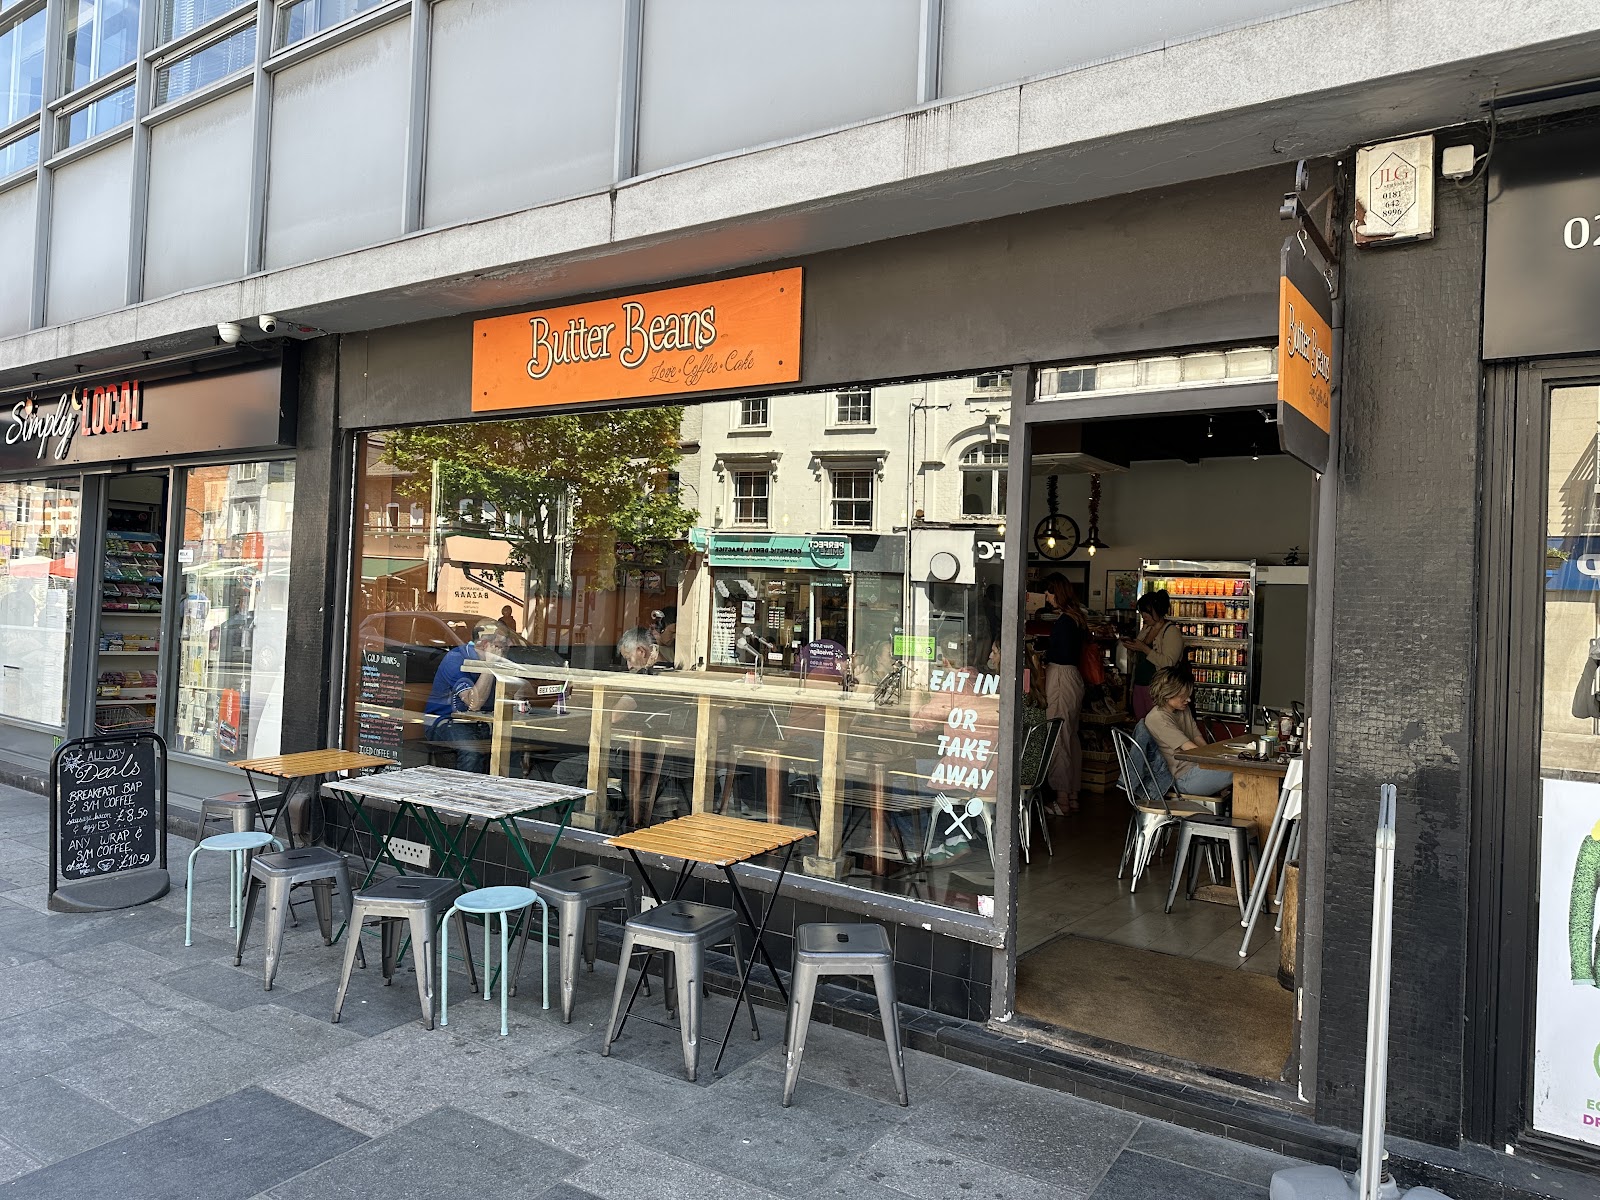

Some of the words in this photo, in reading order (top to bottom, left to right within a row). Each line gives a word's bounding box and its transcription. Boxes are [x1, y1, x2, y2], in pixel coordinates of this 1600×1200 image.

[1376, 165, 1408, 189] JLG
[1382, 191, 1401, 200] 0181
[1385, 200, 1400, 208] 642
[526, 316, 616, 379] Butter
[619, 301, 717, 369] Beans
[1287, 302, 1311, 363] Butter
[1310, 326, 1330, 383] Beans
[648, 360, 680, 384] Love
[682, 354, 718, 387] Coffee
[724, 349, 755, 373] Cake
[5, 392, 76, 460] Simply
[81, 379, 143, 437] LOCAL
[930, 669, 970, 693] EAT
[974, 673, 1001, 695] IN
[948, 707, 978, 733] OR
[87, 750, 104, 762] ALL
[106, 748, 126, 760] DAY
[358, 745, 373, 756] ICED
[373, 748, 391, 759] COFFEE
[937, 735, 991, 762] TAKE
[75, 754, 141, 784] Deals
[931, 763, 994, 791] AWAY
[67, 784, 118, 803] BREAKFAST
[123, 781, 143, 794] BAP
[82, 800, 100, 812] S/M
[103, 794, 136, 808] COFFEE
[116, 808, 149, 822] £8.50
[68, 837, 90, 851] ANY
[100, 829, 130, 845] WRAP
[82, 823, 97, 834] egg
[76, 848, 94, 862] S/M
